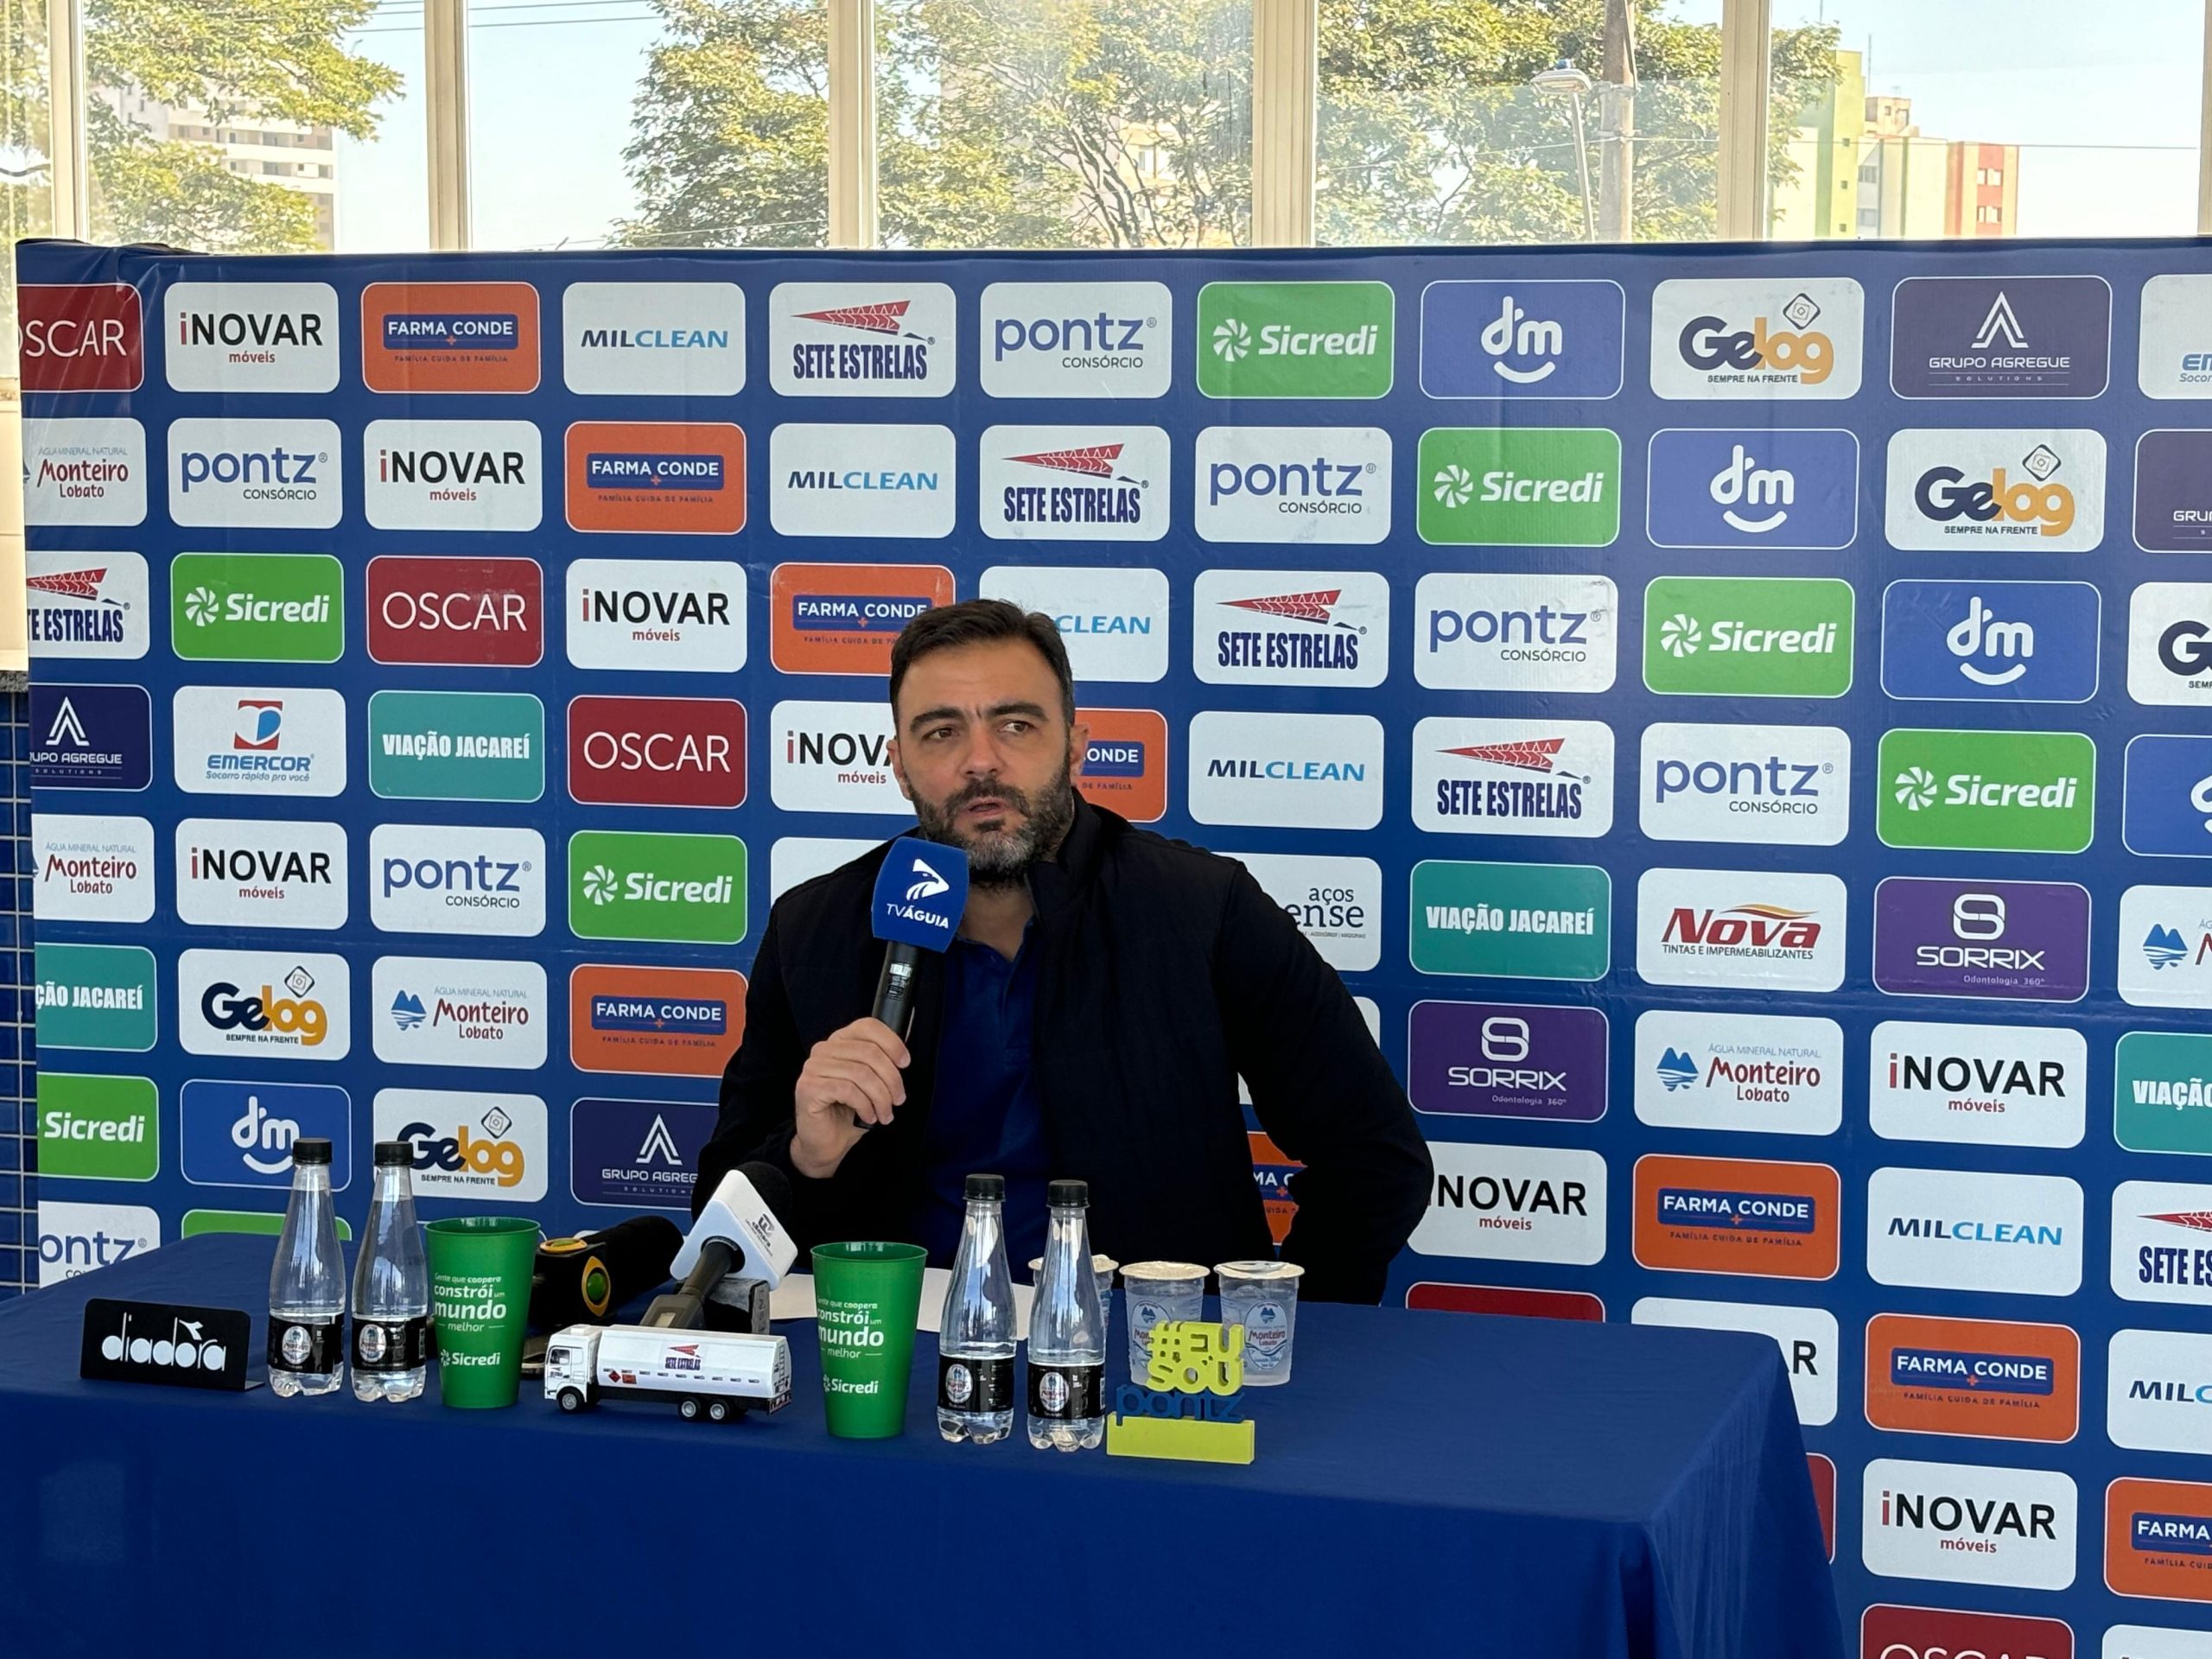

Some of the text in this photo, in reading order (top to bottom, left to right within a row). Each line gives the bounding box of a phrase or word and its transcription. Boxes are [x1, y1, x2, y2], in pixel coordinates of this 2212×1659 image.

[181, 313, 322, 346] iNOVAR
[389, 321, 512, 334] FARMA CONDE
[582, 330, 728, 347] MILCLEAN
[1259, 325, 1378, 355] Sicredi
[230, 351, 275, 363] móveis
[1679, 316, 1834, 384] Gelog
[793, 344, 927, 379] SETE ESTRELAS
[1063, 355, 1143, 368] CONSÓRCIO
[1929, 357, 2070, 368] GRUPO AGREGUE
[37, 459, 128, 487] Monteiro
[381, 450, 524, 484] iNOVAR
[593, 461, 718, 475] FARMA CONDE
[60, 484, 104, 498] Lobato
[788, 472, 937, 490] MILCLEAN
[1481, 472, 1604, 502] Sicredi
[244, 487, 316, 499] CONSÓRCIO
[430, 488, 476, 500] móveis
[1915, 467, 2074, 536] Gelog
[1004, 486, 1140, 523] SETE ESTRELAS
[1279, 500, 1362, 513] CONSÓRCIO
[226, 594, 329, 622] Sicredi
[383, 592, 526, 631] OSCAR
[583, 589, 729, 625] iNOVAR
[798, 602, 859, 616] FARMA
[44, 608, 123, 642] ESTRELAS
[632, 628, 680, 641] móveis
[1708, 621, 1836, 652] Sicredi
[1218, 632, 1357, 670] SETE ESTRELAS
[1501, 649, 1586, 662] CONSÓRCIO
[383, 731, 530, 760] VIAÇÃO JACAREÍ
[584, 732, 730, 772] OSCAR
[61, 753, 122, 764] AGREGUE
[207, 755, 311, 771] EMERCOR
[838, 771, 886, 784] móveis
[1208, 760, 1363, 781] MILCLEAN
[1438, 779, 1581, 819] SETE ESTRELAS
[1945, 775, 2077, 808] Sicredi
[1730, 800, 1818, 814] CONSÓRCIO
[45, 855, 137, 881] Monteiro
[192, 848, 331, 884] iNOVAR
[71, 879, 112, 893] Lobato
[239, 886, 284, 899] móveis
[625, 873, 733, 903] Sicredi
[446, 895, 519, 908] CONSÓRCIO
[1309, 888, 1353, 906] aços
[1426, 904, 1594, 935] VIAÇÃO JACAREÍ
[1662, 908, 1821, 948] Nova
[1662, 944, 1813, 959] TINTAS E IMPERMEABILIZANTES
[1917, 946, 2044, 970] SORRIX
[1964, 976, 2018, 986] Odontologia
[73, 985, 143, 1009] JACAREÍ
[201, 982, 327, 1045] Gelog
[433, 999, 528, 1027] Monteiro
[597, 1002, 721, 1020] FARMA CONDE
[460, 1024, 503, 1039] Lobato
[1448, 1067, 1566, 1091] SORRIX
[1707, 1057, 1820, 1087] Monteiro
[1891, 1053, 2065, 1096] iNOVAR
[1492, 1095, 1541, 1105] Odontologia
[1738, 1085, 1789, 1102] Lobato
[1948, 1098, 2005, 1112] móveis
[44, 1112, 144, 1142] Sicredi
[397, 1122, 524, 1187] Gelog
[602, 1169, 648, 1180] GRUPO
[1664, 1196, 1808, 1217] FARMA CONDE
[1480, 1216, 1531, 1230] móveis
[1888, 1218, 2062, 1245] MILCLEAN
[2139, 1246, 2188, 1285] SETE
[435, 1285, 493, 1298] constrói
[435, 1300, 507, 1319] mundo
[448, 1322, 485, 1332] melhor
[818, 1325, 884, 1346] mundo
[102, 1313, 226, 1371] diadora
[451, 1352, 501, 1365] Sicredi
[827, 1348, 861, 1358] melhor
[1897, 1356, 2046, 1380] FARMA CONDE
[831, 1378, 880, 1394] Sicredi
[1883, 1491, 2056, 1540] iNOVAR
[2139, 1521, 2210, 1540] FARMA
[1941, 1537, 1996, 1553] móveis
